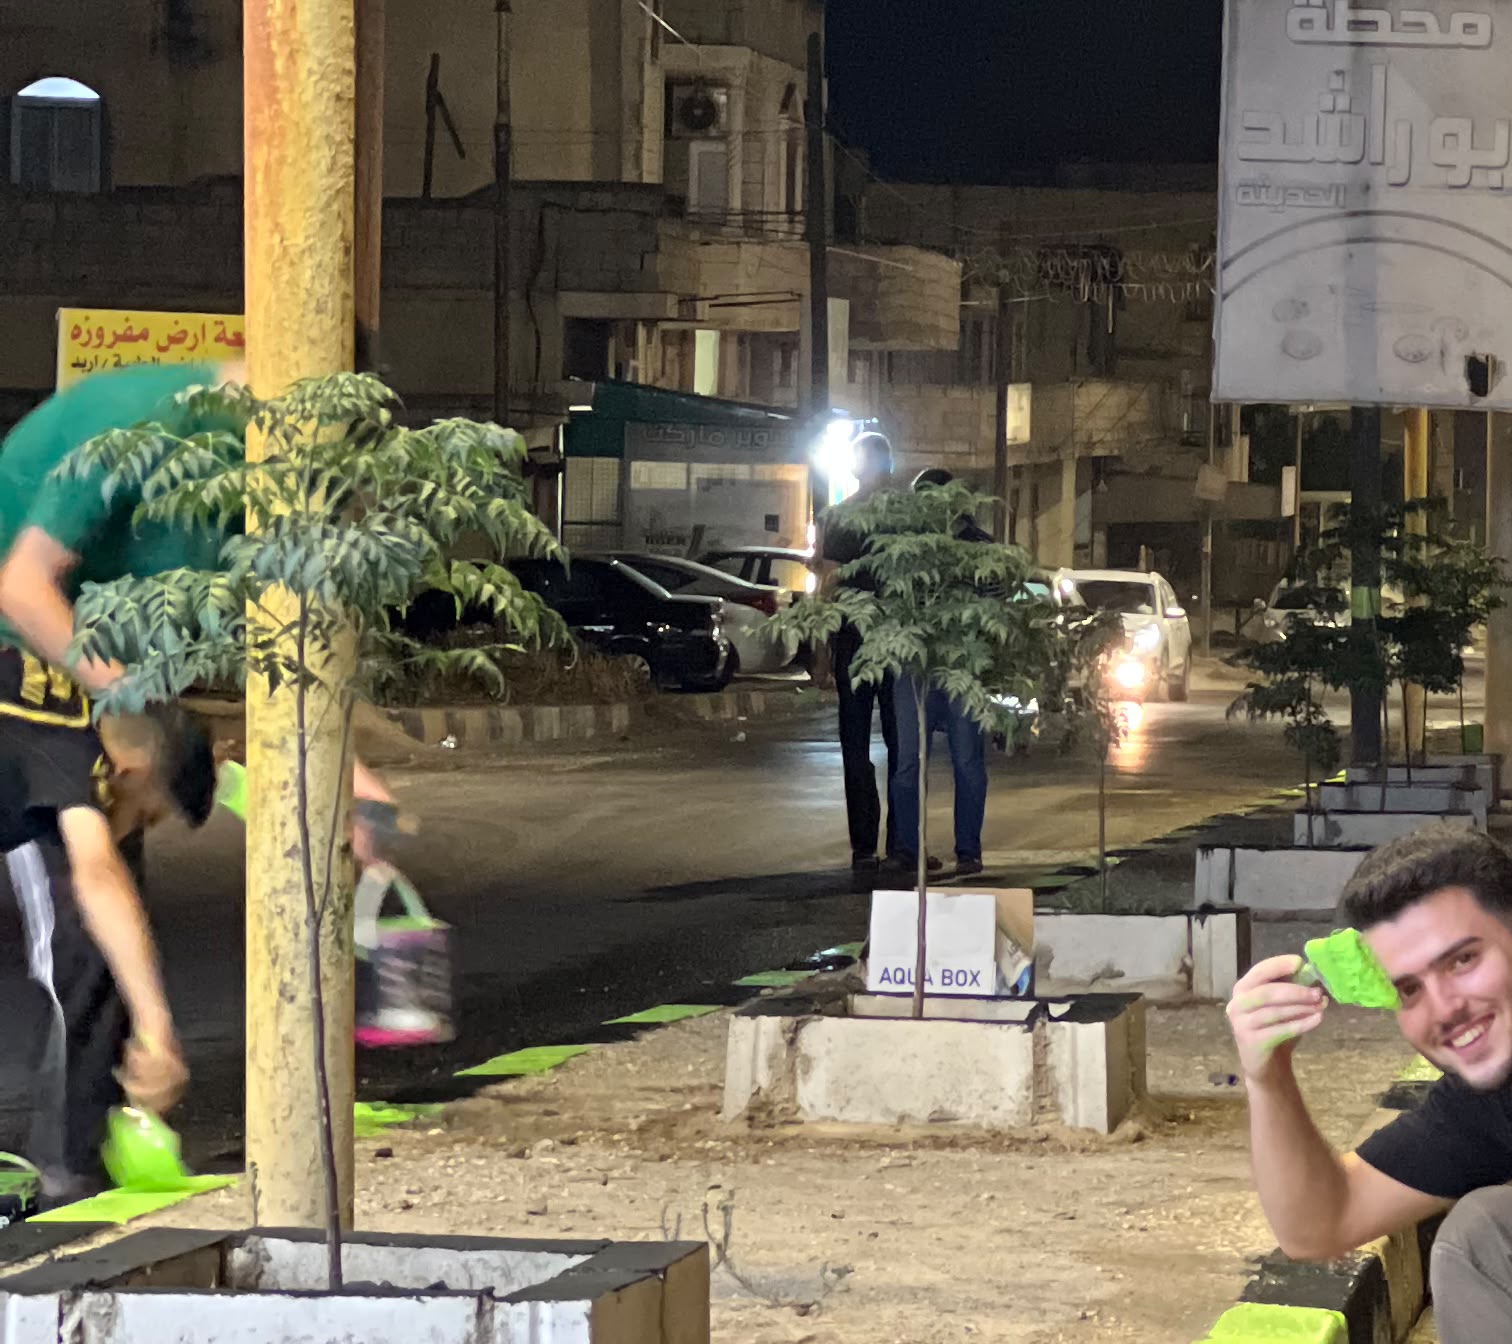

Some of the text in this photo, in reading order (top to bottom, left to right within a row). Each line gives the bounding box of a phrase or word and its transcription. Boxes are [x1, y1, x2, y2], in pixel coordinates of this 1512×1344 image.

[1237, 63, 1413, 187] راشد
[1235, 173, 1346, 214] الحديثة
[643, 423, 725, 449] ماركت
[879, 967, 981, 987] AQUA BOX
